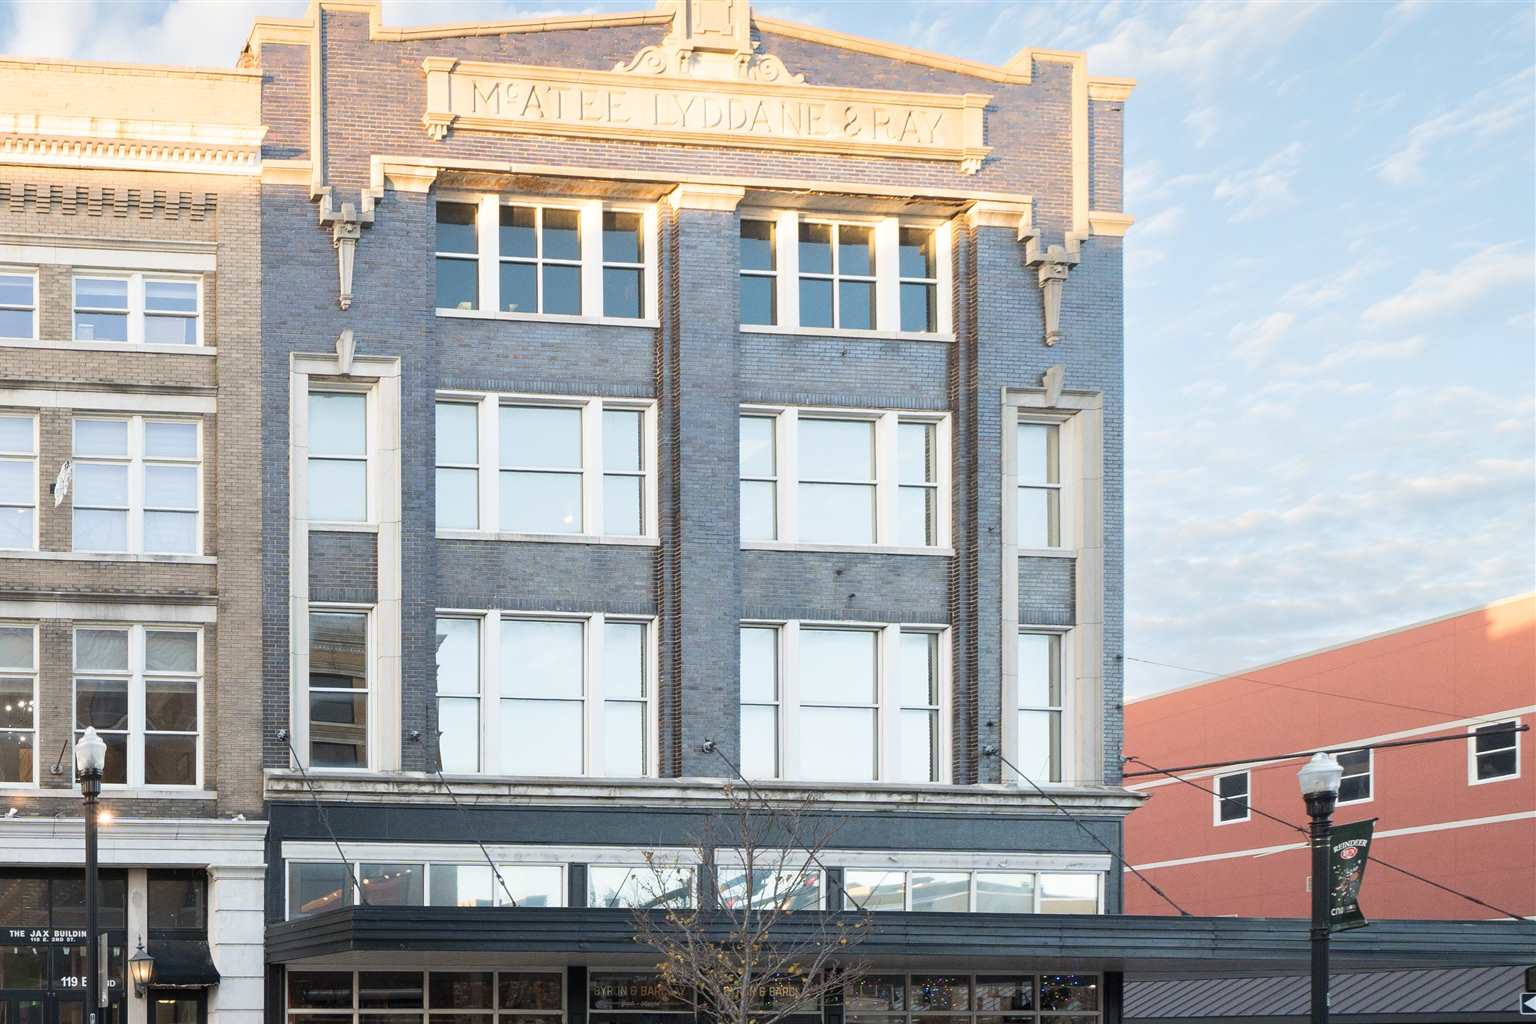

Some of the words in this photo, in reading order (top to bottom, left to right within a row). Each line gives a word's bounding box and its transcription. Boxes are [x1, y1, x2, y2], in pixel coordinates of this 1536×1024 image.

[653, 93, 827, 138] LYDDANE
[842, 105, 863, 137] &
[872, 107, 944, 144] RAY
[1333, 838, 1368, 853] REINDEER
[54, 930, 87, 938] BUILDIN
[60, 976, 78, 987] 119
